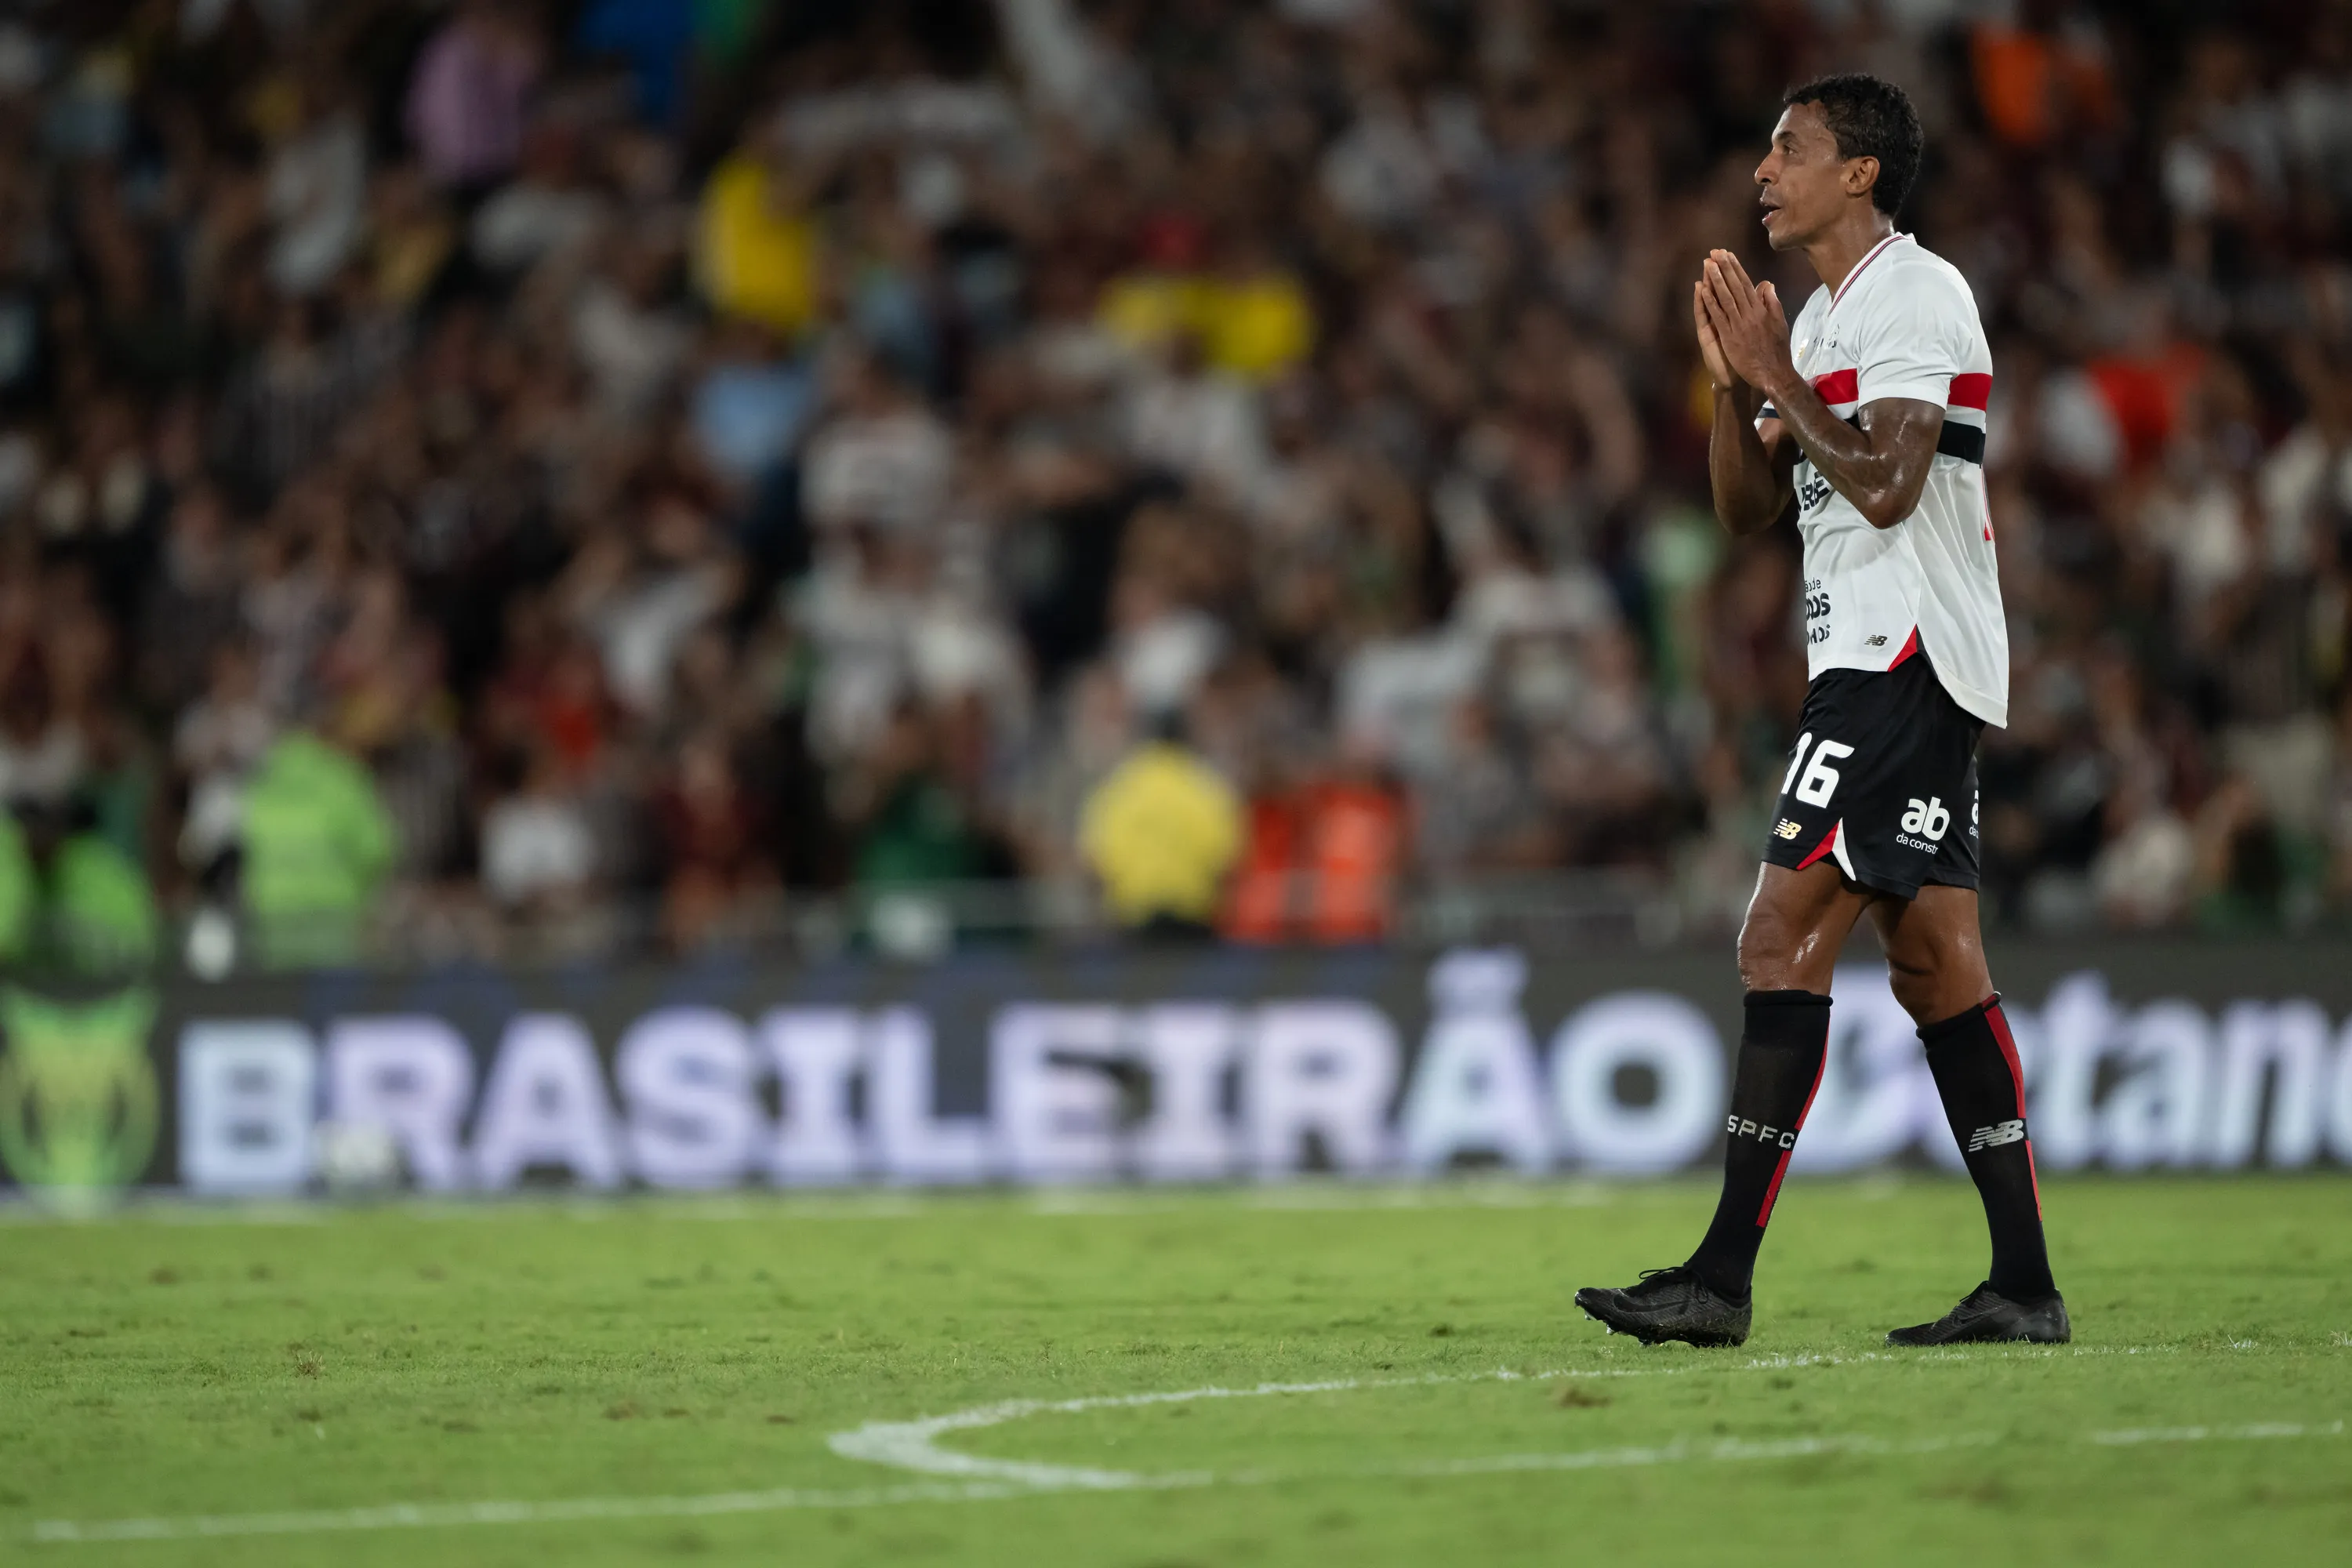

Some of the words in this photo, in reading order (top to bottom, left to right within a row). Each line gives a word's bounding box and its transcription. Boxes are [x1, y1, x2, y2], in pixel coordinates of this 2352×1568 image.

[1780, 731, 1856, 808] 16
[1896, 833, 1909, 845] da
[177, 949, 1725, 1192] BRASILEIRÃO
[1791, 963, 2352, 1173] Btan
[1727, 1115, 1795, 1149] SPFC
